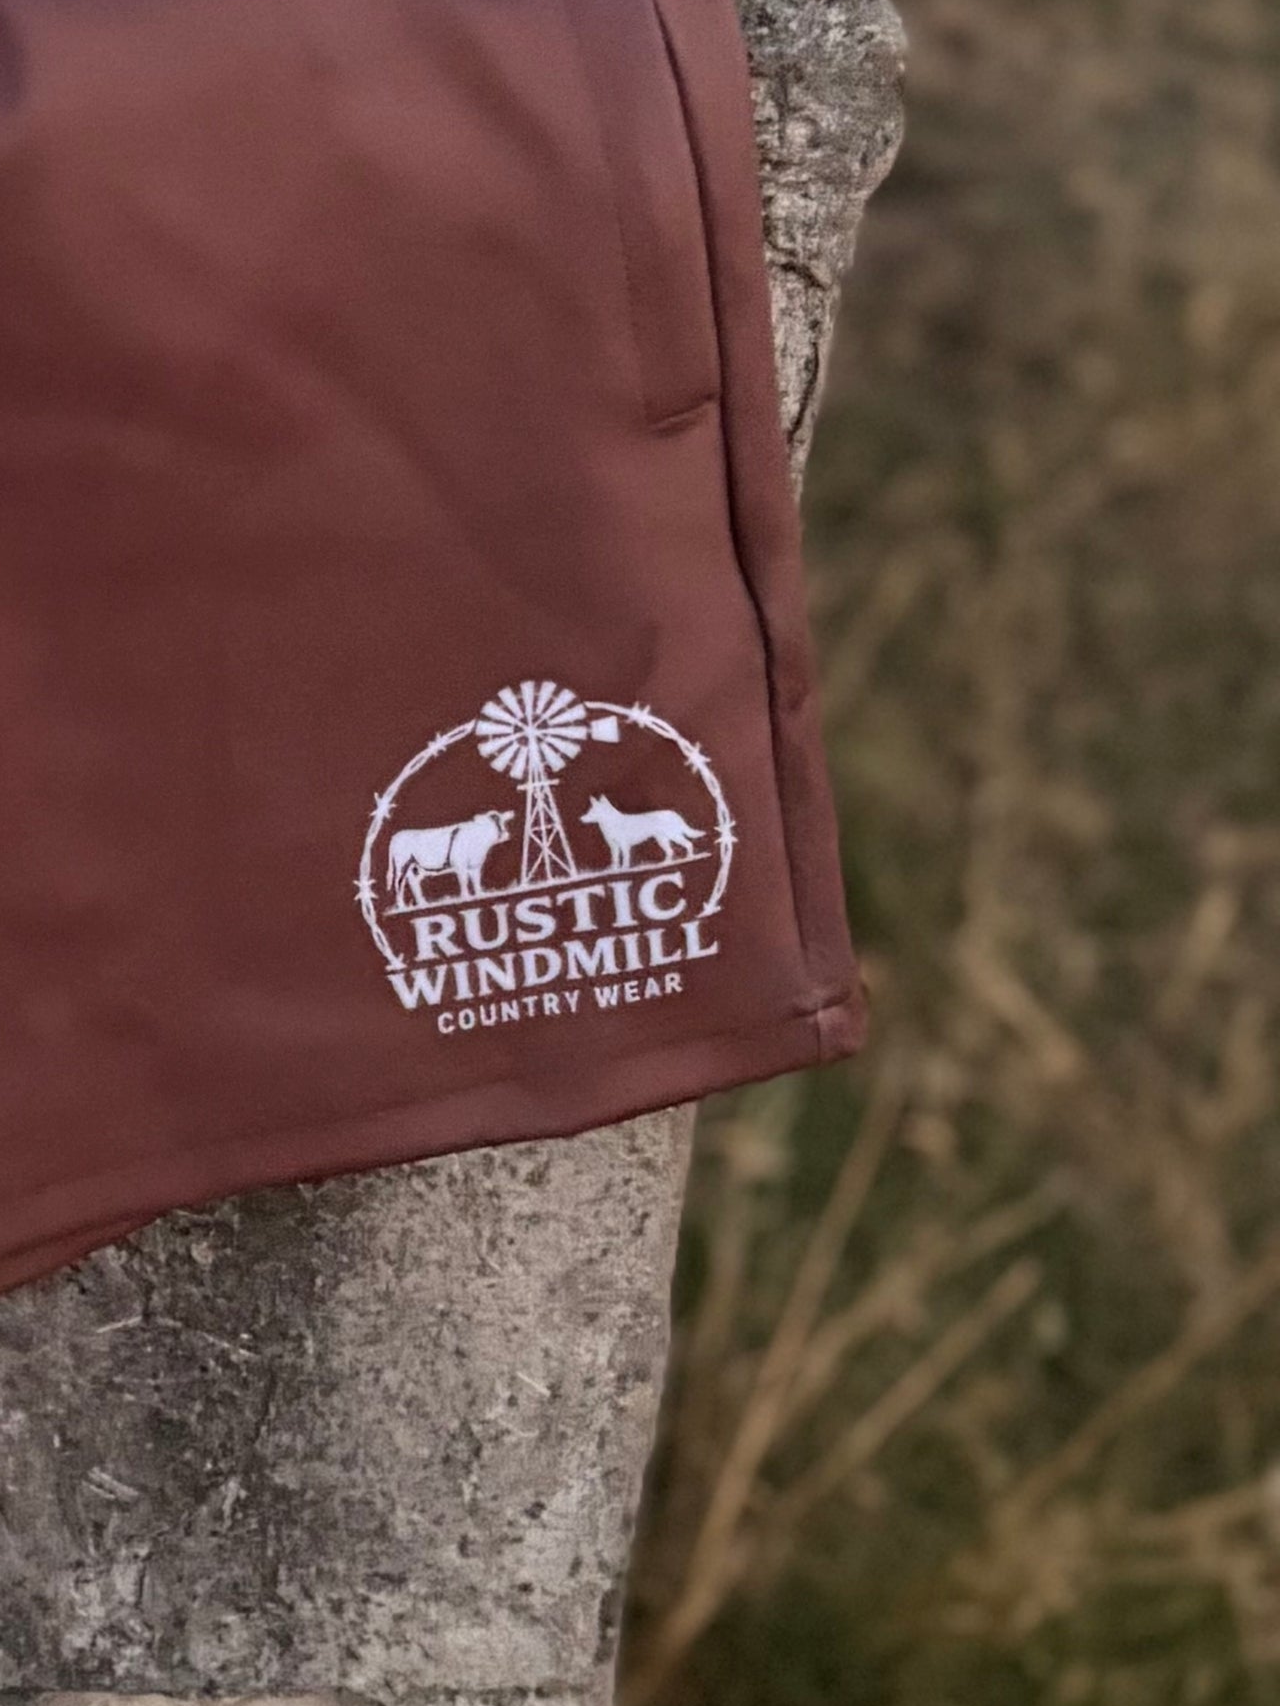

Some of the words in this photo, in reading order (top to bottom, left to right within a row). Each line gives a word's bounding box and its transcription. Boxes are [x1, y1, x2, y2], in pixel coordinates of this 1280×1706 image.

[411, 872, 686, 961] RUSTIC
[387, 921, 719, 1010] WINDMILL
[437, 990, 579, 1034] COUNTRY
[594, 972, 684, 1008] WEAR
